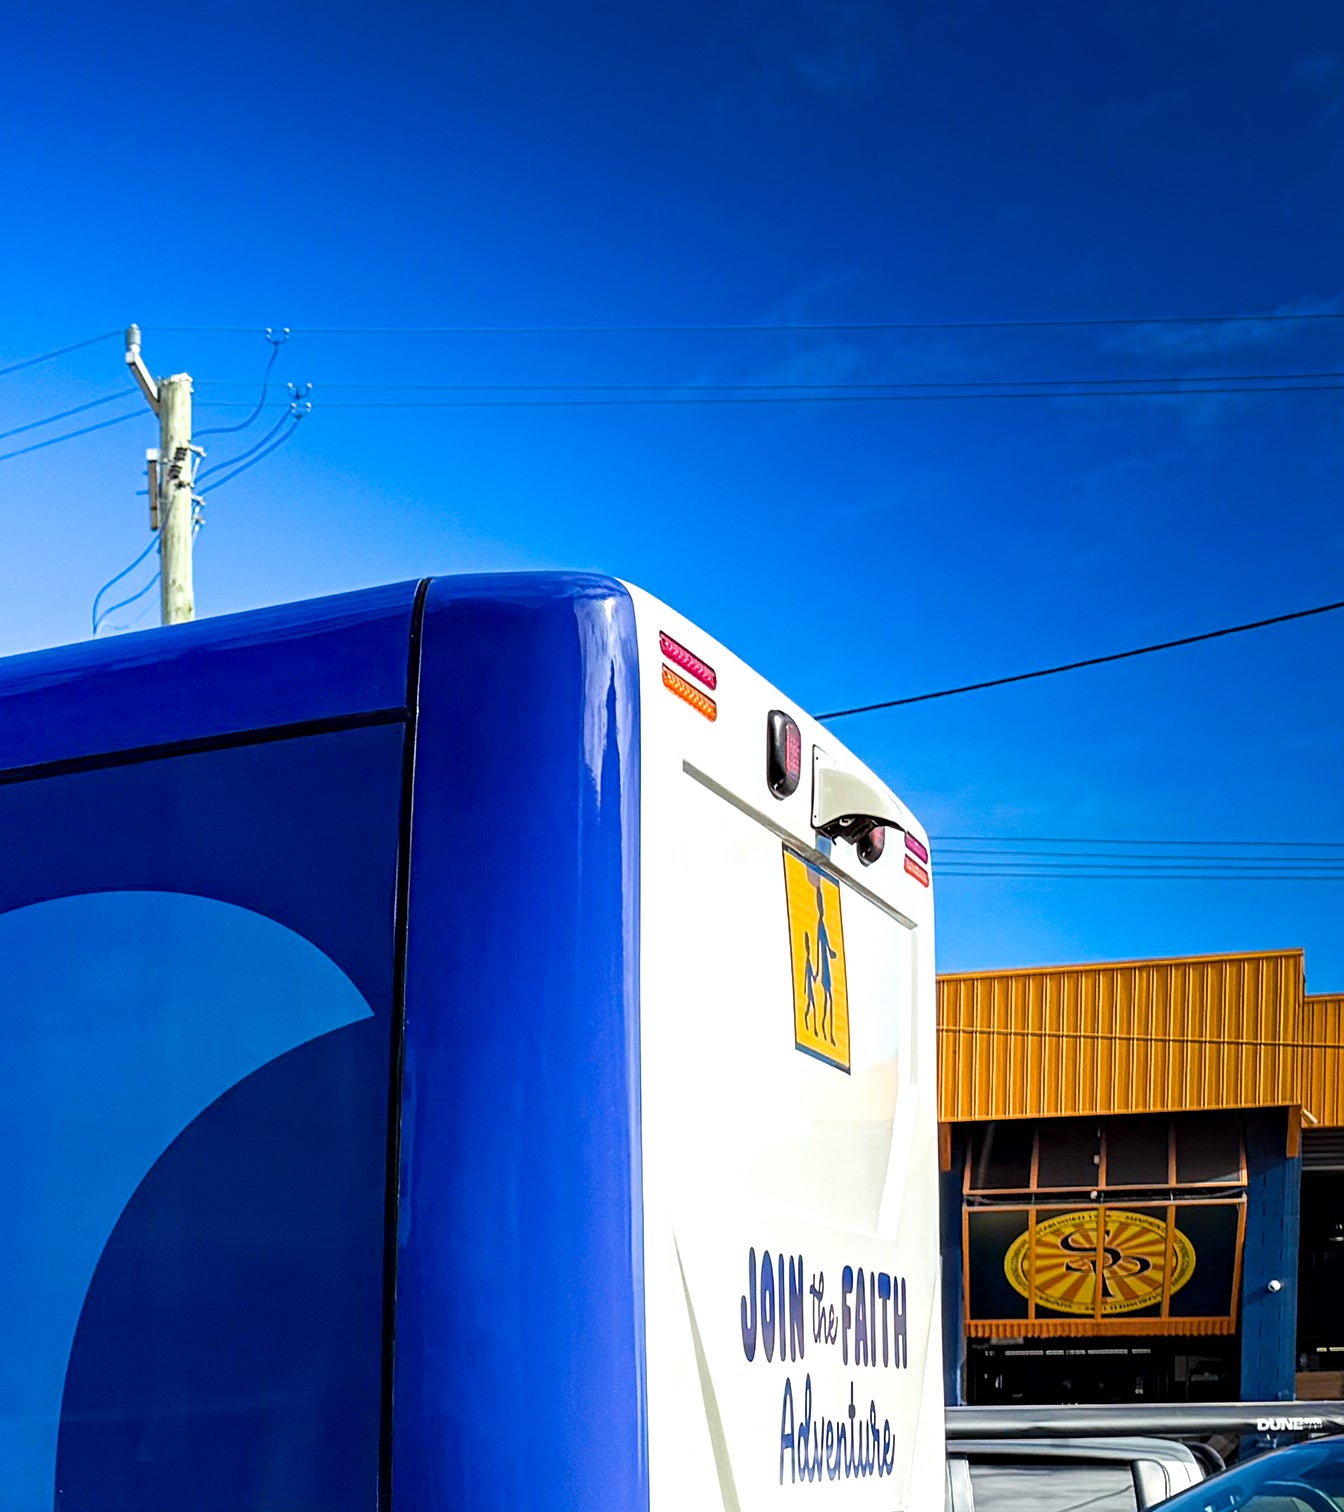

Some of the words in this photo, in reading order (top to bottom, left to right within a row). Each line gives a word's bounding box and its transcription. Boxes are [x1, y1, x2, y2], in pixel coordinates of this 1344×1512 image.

[740, 1246, 805, 1363] JOIN
[809, 1271, 839, 1345] the
[841, 1265, 908, 1369] FAITH
[779, 1373, 896, 1485] Adventure
[1256, 1417, 1304, 1431] DUNE
